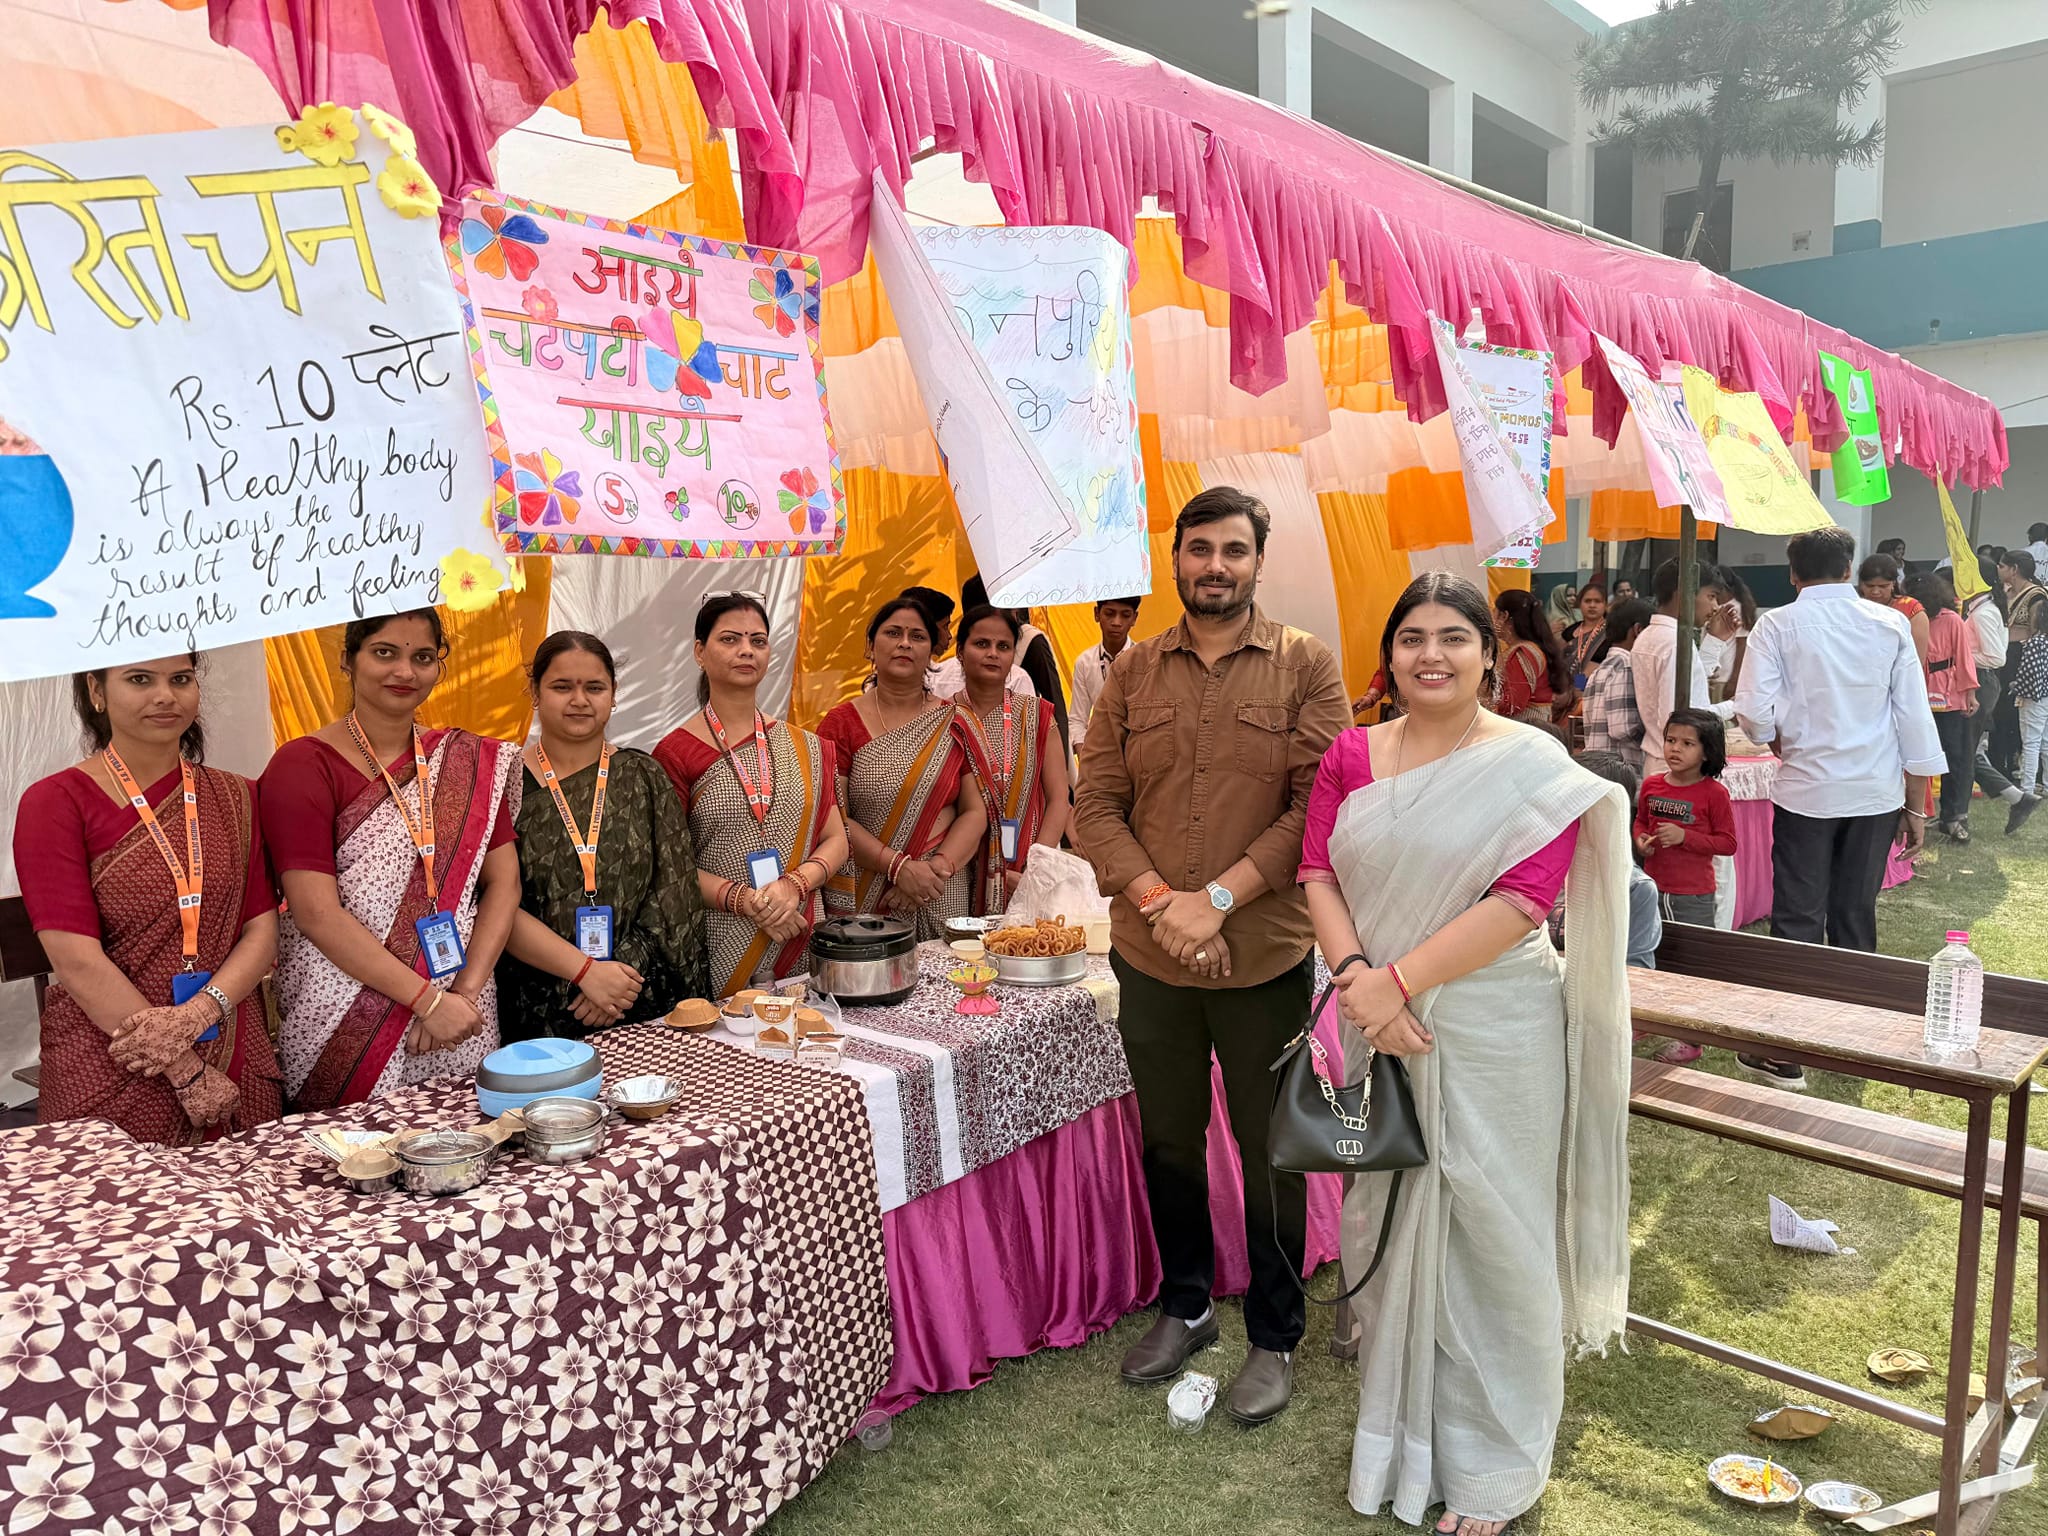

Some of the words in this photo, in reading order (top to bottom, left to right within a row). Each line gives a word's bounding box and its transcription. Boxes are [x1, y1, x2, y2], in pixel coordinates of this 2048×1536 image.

[342, 324, 460, 403] प्लेट
[481, 307, 647, 387] चटपटी
[715, 343, 799, 400] चाट
[170, 375, 241, 448] Rs.
[257, 360, 335, 430] 10
[1499, 413, 1541, 428] MOMOS
[131, 458, 175, 528] A
[197, 432, 369, 518] Healthy
[379, 427, 458, 502] body
[602, 478, 625, 516] 5
[721, 484, 746, 524] 10
[88, 533, 134, 565] is
[153, 509, 274, 550] always
[285, 494, 332, 528] the
[107, 549, 224, 598] result
[253, 534, 285, 587] of
[296, 513, 425, 562] healthy
[78, 592, 237, 651] thoughts
[260, 566, 327, 615] and
[344, 554, 445, 618] feeling
